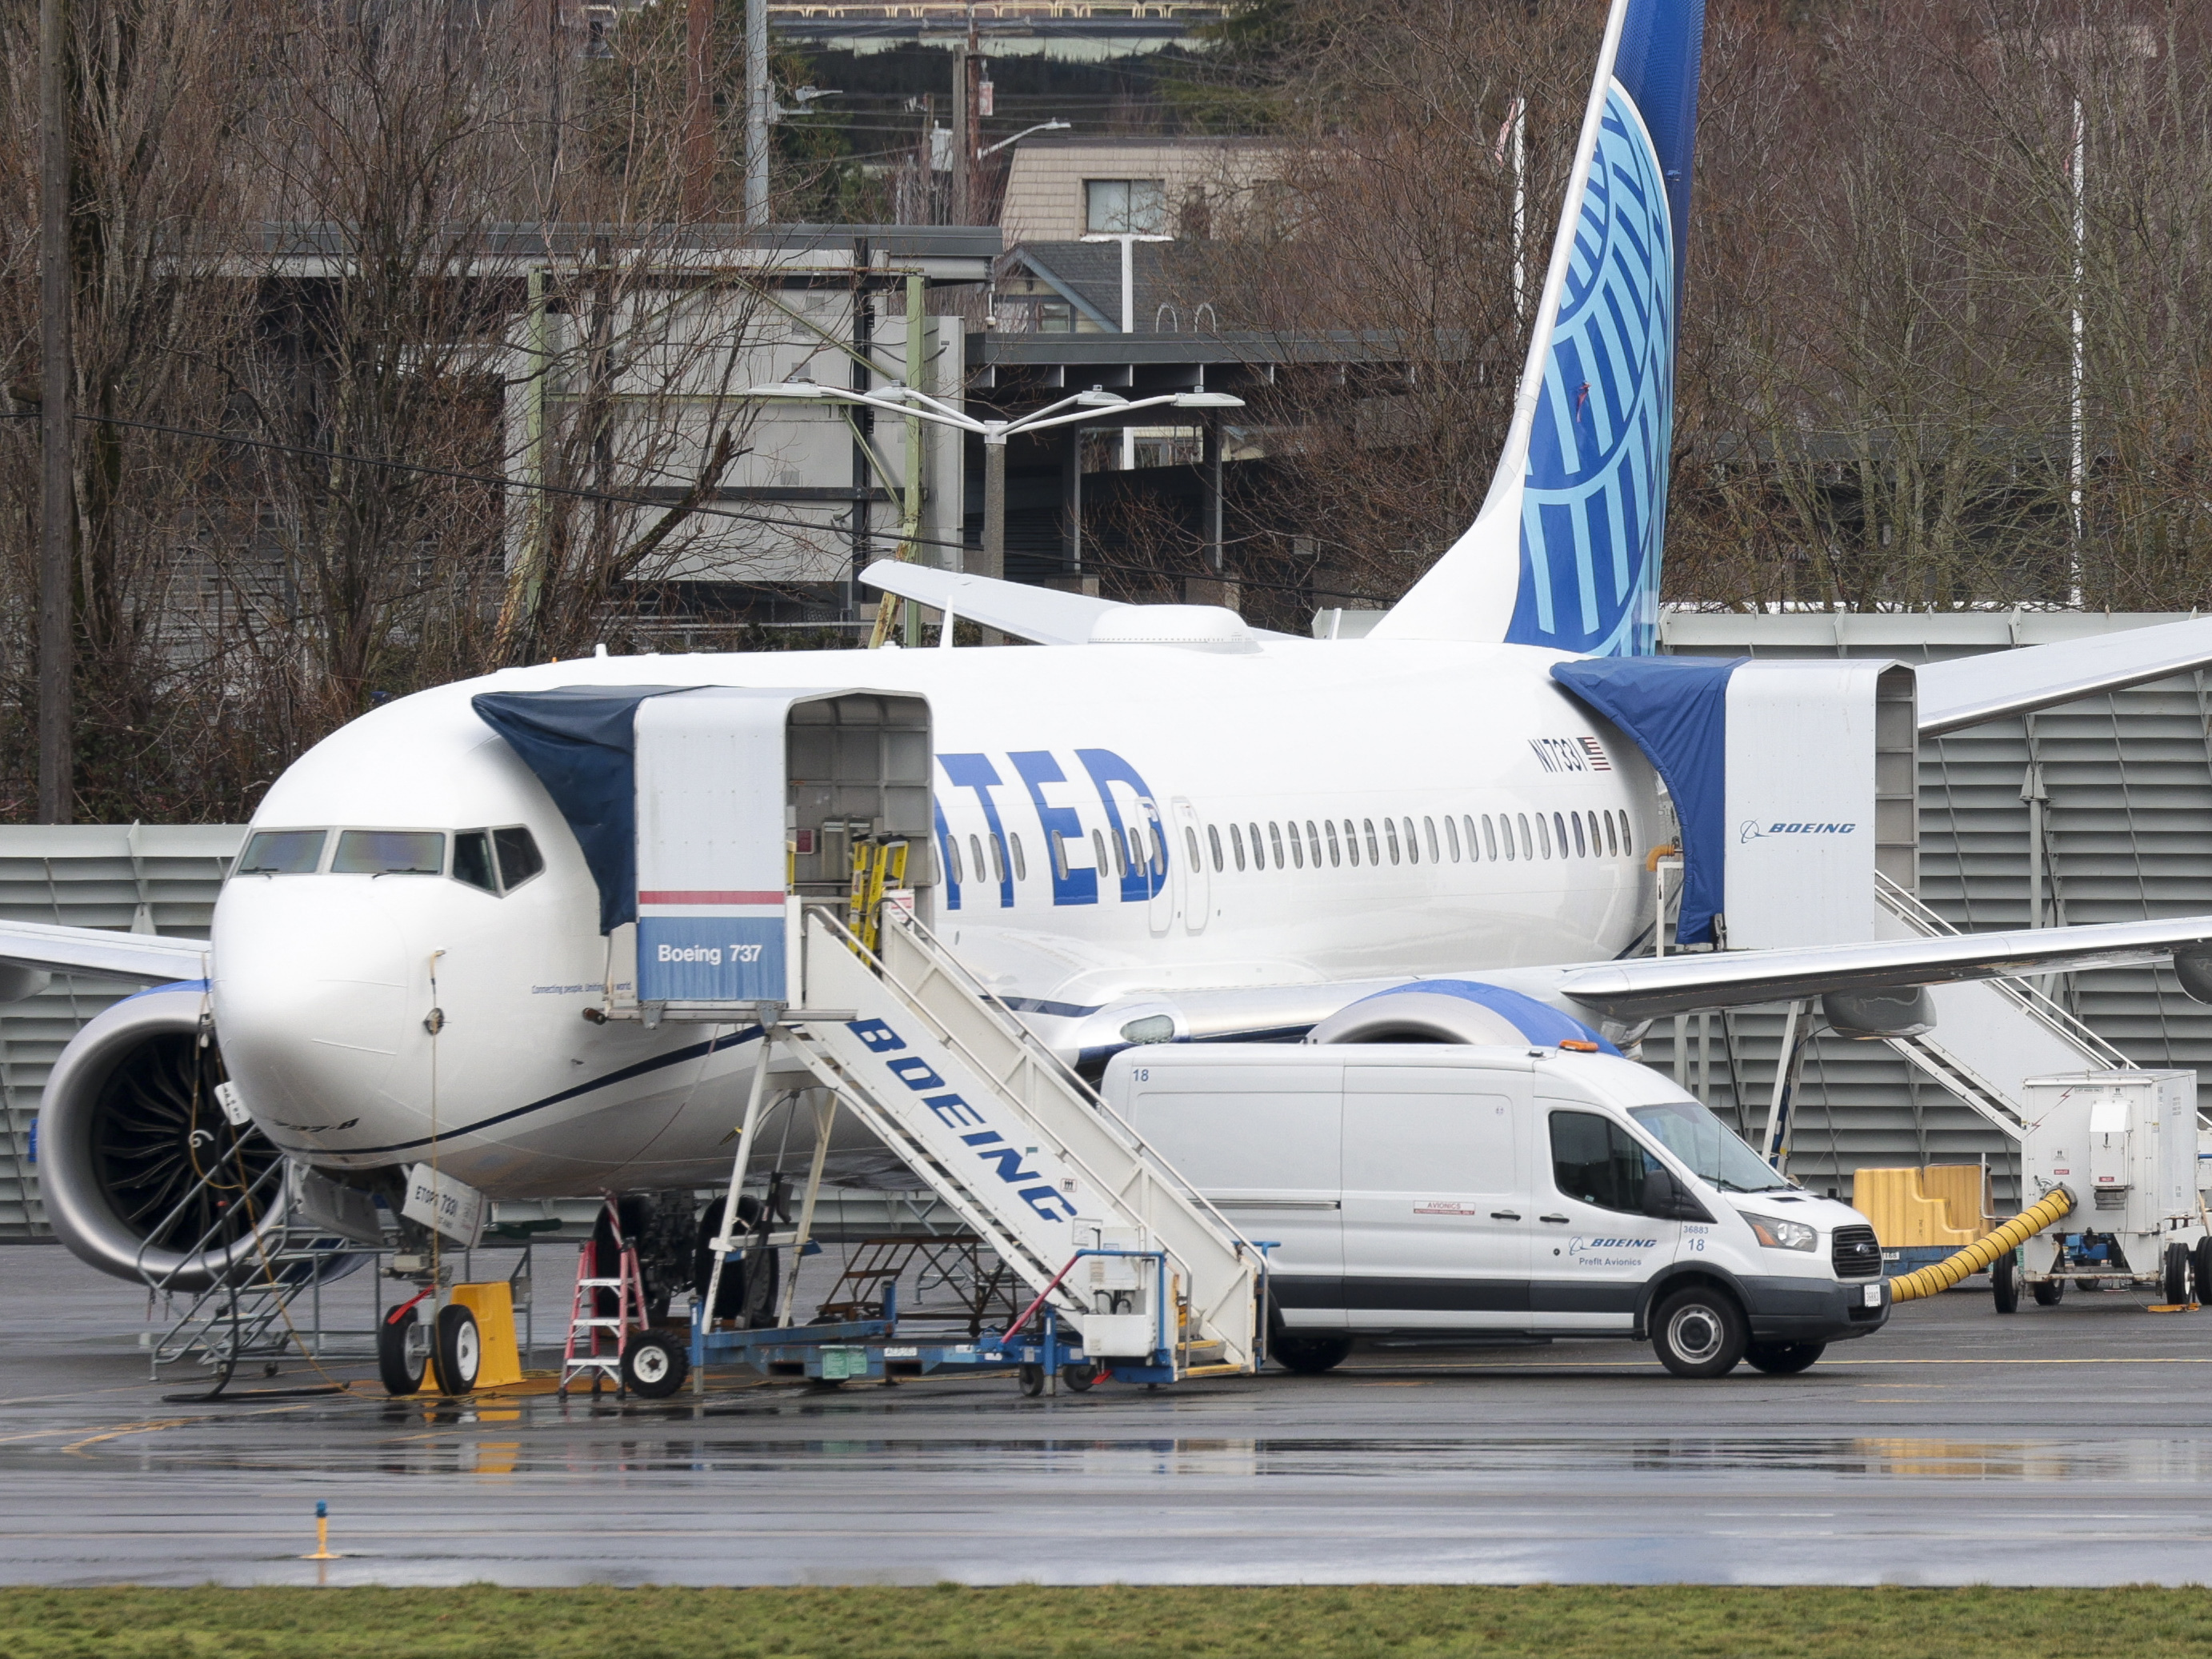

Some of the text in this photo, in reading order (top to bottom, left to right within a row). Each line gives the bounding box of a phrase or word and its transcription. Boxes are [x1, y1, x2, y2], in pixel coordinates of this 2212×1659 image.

[1527, 738, 1588, 773] N17331
[1768, 823, 1856, 833] BOEING
[658, 944, 762, 965] Boeing 737
[1133, 1069, 1149, 1081] 18
[846, 1018, 1077, 1223] BOEING
[1683, 1225, 1709, 1234] 36883
[1590, 1238, 1657, 1248] BOEING
[1688, 1238, 1705, 1251] 18
[1604, 1257, 1642, 1266] Avionics
